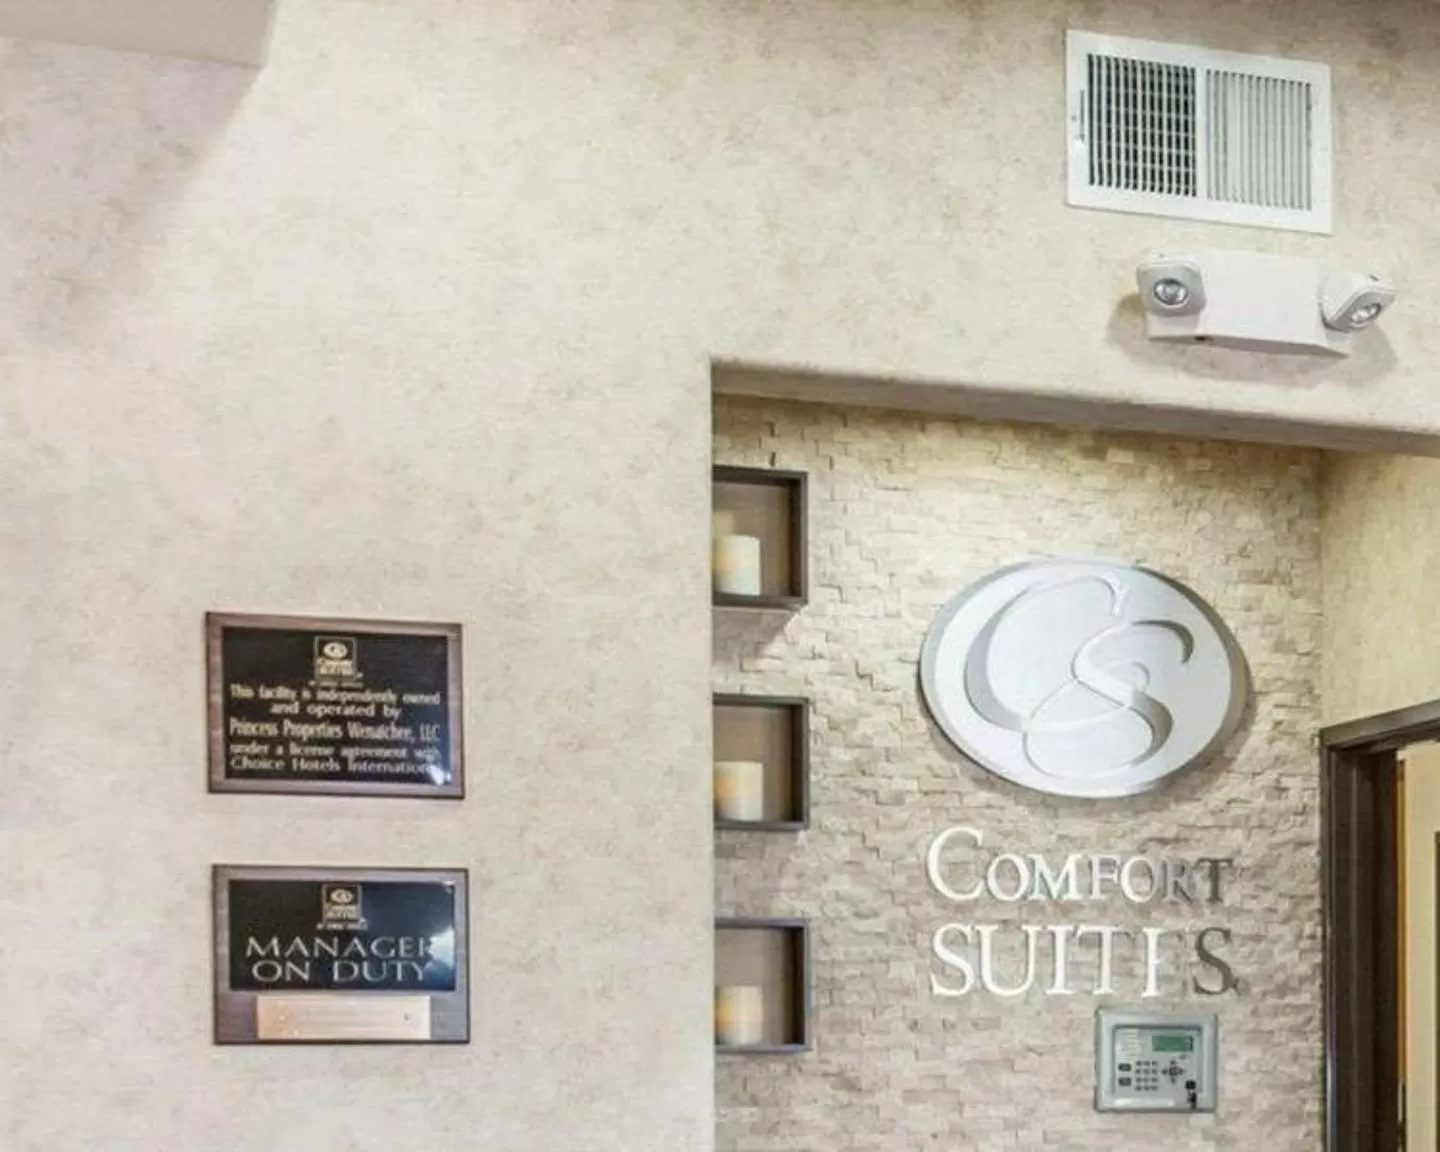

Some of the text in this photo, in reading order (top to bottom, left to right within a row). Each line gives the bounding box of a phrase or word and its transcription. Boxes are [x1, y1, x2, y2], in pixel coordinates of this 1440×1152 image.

[269, 701, 402, 720] and operated by
[230, 756, 285, 769] Choice
[292, 757, 341, 771] Hotels
[252, 960, 433, 982] ON DUTY
